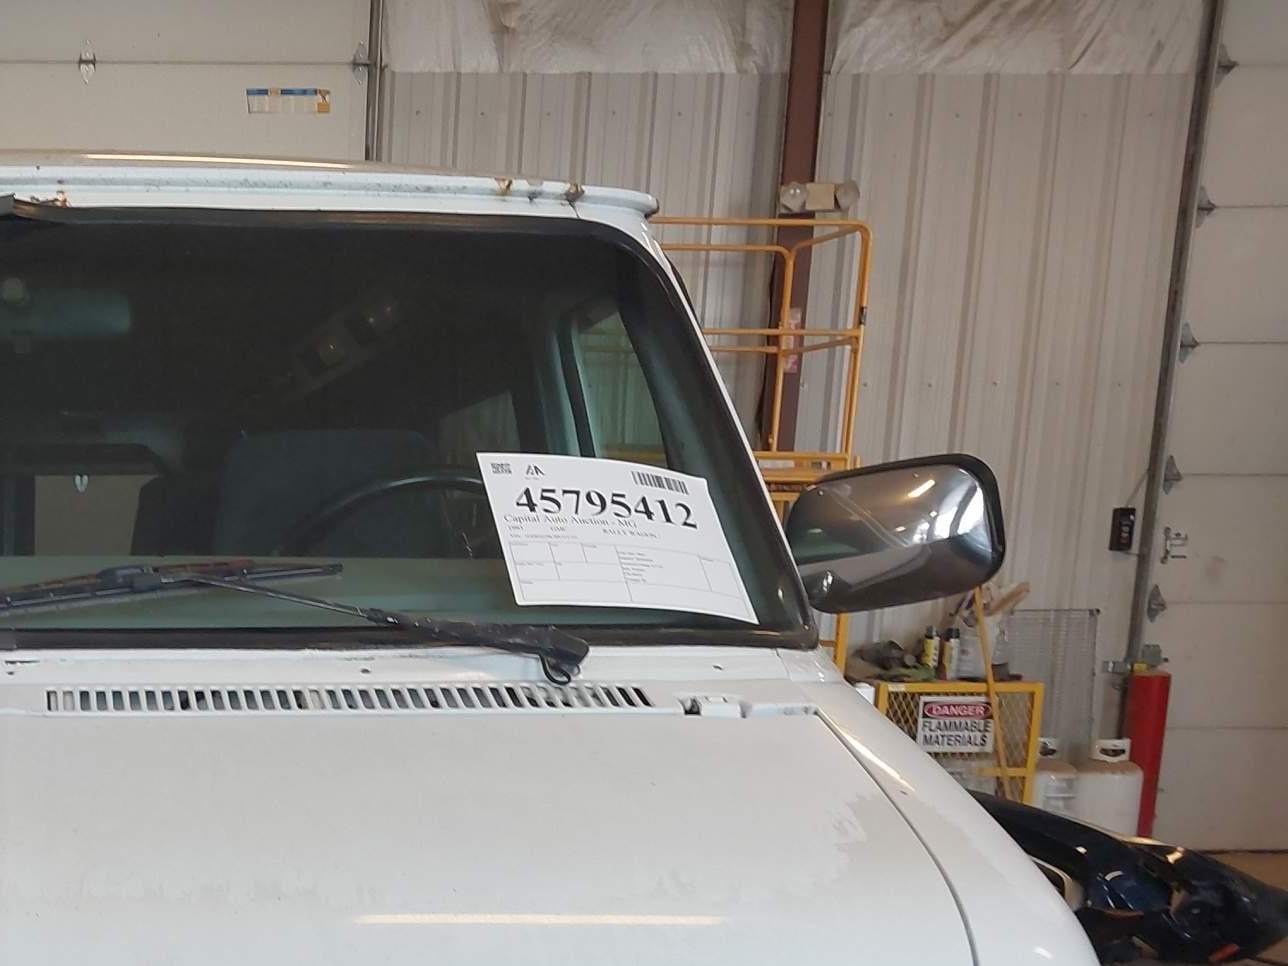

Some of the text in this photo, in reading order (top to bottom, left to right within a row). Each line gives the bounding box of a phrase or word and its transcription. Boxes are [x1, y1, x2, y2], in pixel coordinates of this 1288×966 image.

[516, 486, 698, 529] 45795412
[932, 705, 985, 716] DANGER
[922, 720, 991, 733] FLAMMABLE
[922, 734, 988, 747] MATERIALS
